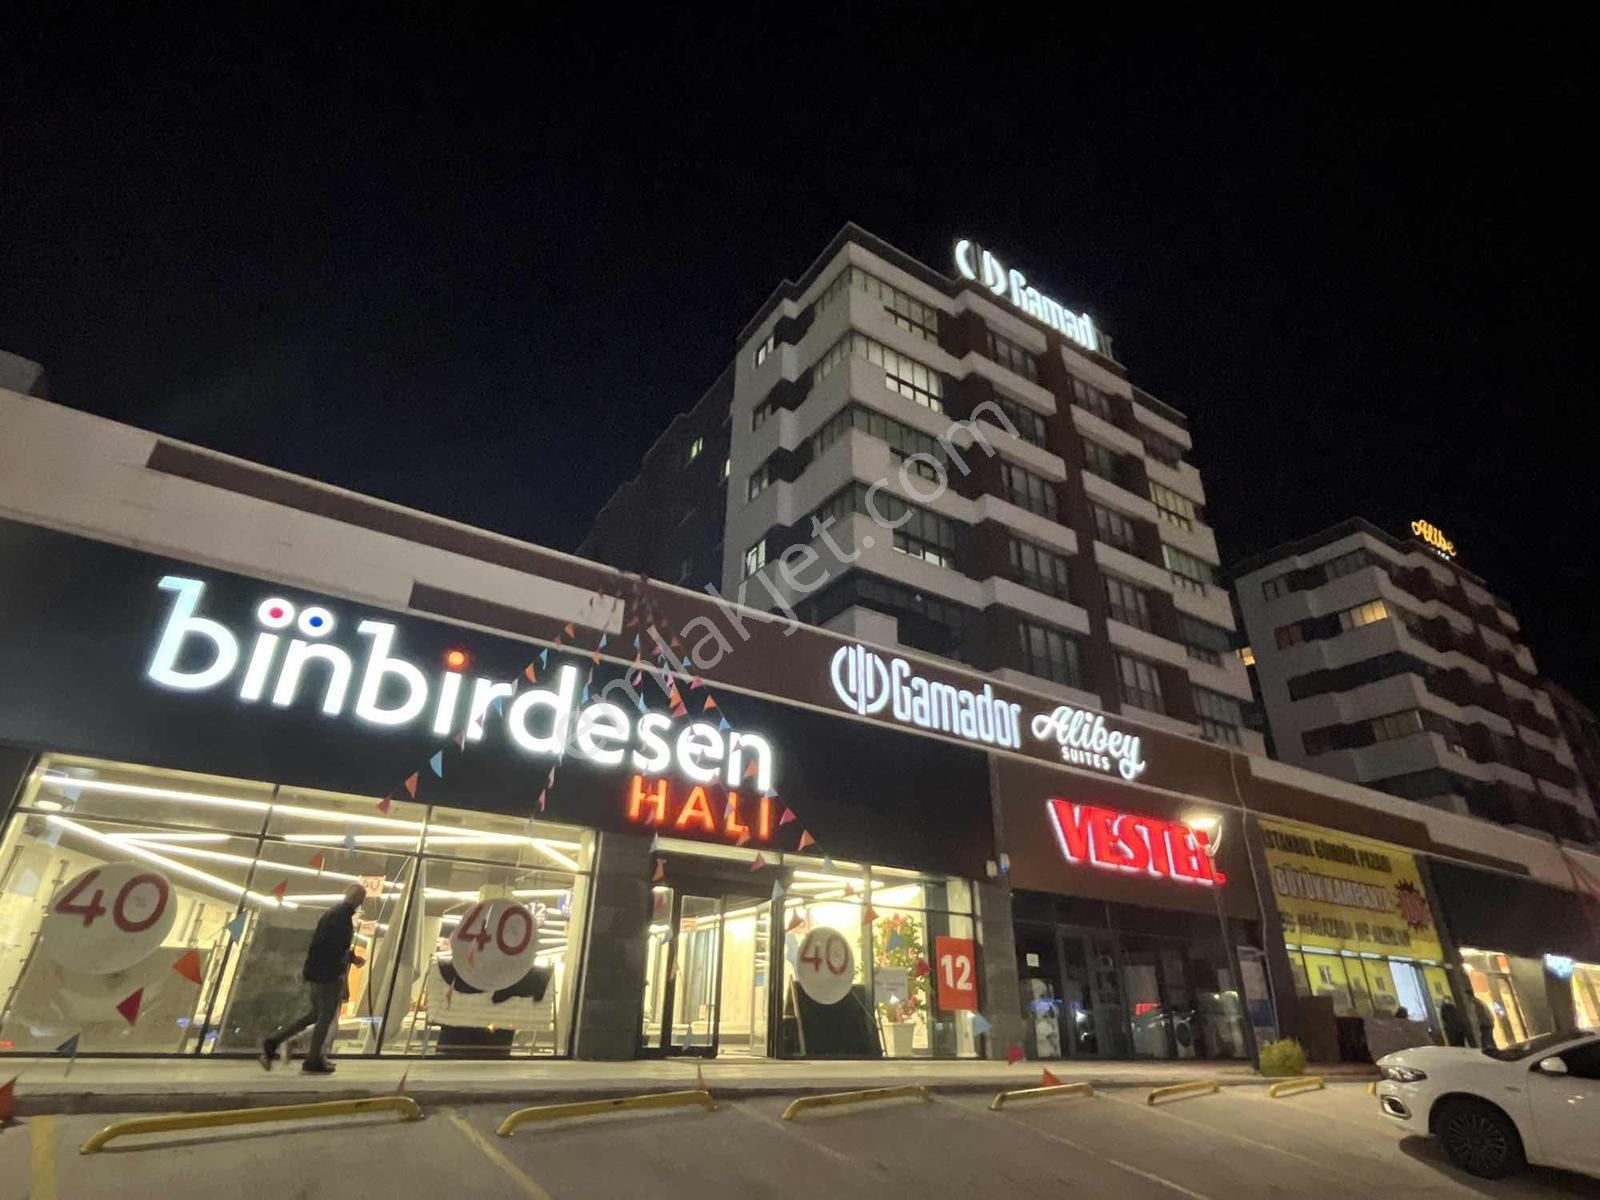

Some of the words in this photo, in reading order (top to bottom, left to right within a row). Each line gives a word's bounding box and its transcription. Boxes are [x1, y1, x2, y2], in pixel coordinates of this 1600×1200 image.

[891, 658, 1022, 750] Gamador
[1031, 705, 1146, 780] Alibey
[1061, 745, 1111, 771] SUITES
[629, 774, 771, 840] HALI
[55, 869, 169, 934] 40
[457, 901, 533, 957] 40
[801, 933, 849, 976] 40
[940, 954, 973, 991] 12
